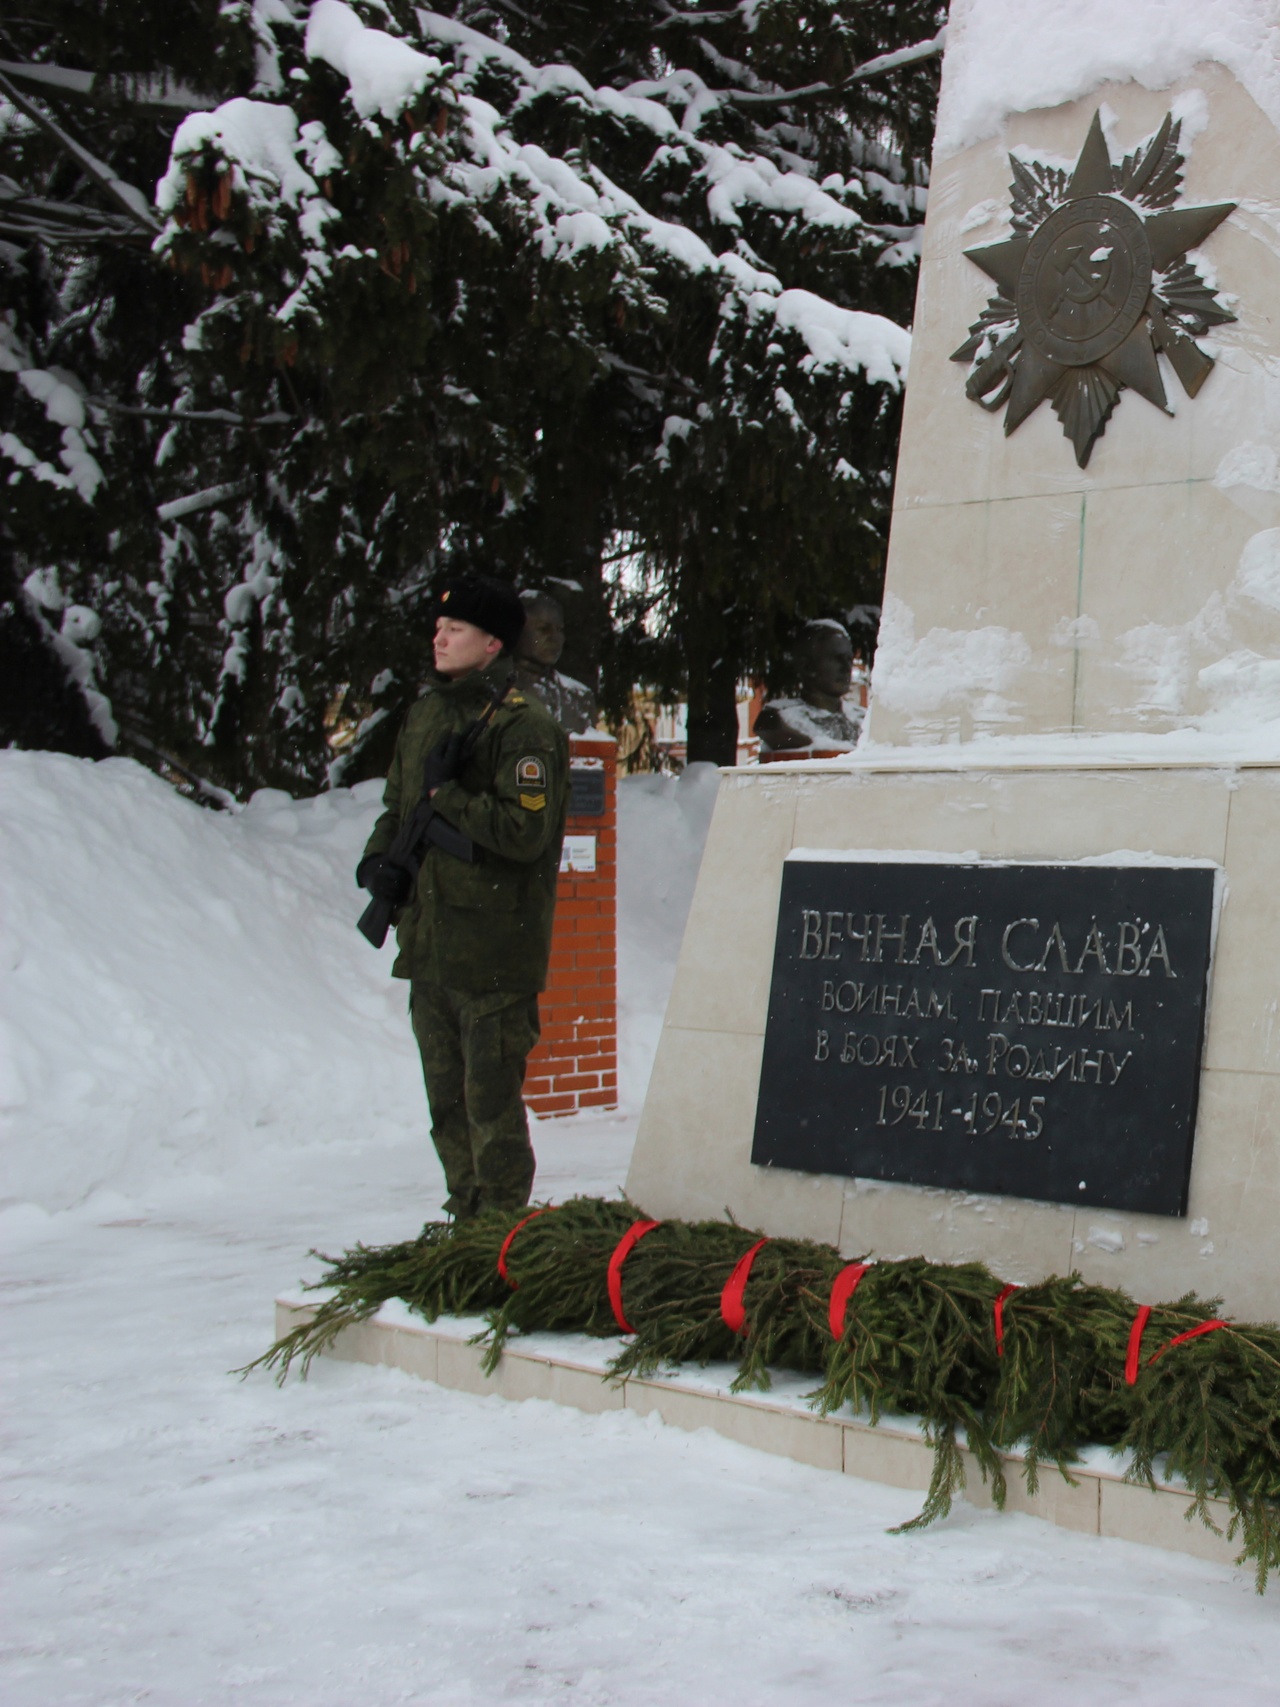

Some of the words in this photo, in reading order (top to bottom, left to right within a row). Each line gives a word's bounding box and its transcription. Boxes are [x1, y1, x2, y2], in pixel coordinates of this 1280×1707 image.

[799, 910, 978, 967] ВЕЧНАЯ
[1002, 918, 1177, 978] СЛАВА
[977, 989, 1134, 1031] ПАВШИМ
[815, 1029, 829, 1061] В
[840, 1031, 919, 1069] БОЯХ
[937, 1038, 973, 1074] ЗА
[986, 1033, 1132, 1085] РОДИНУ
[876, 1085, 1046, 1140] 1941-1945
